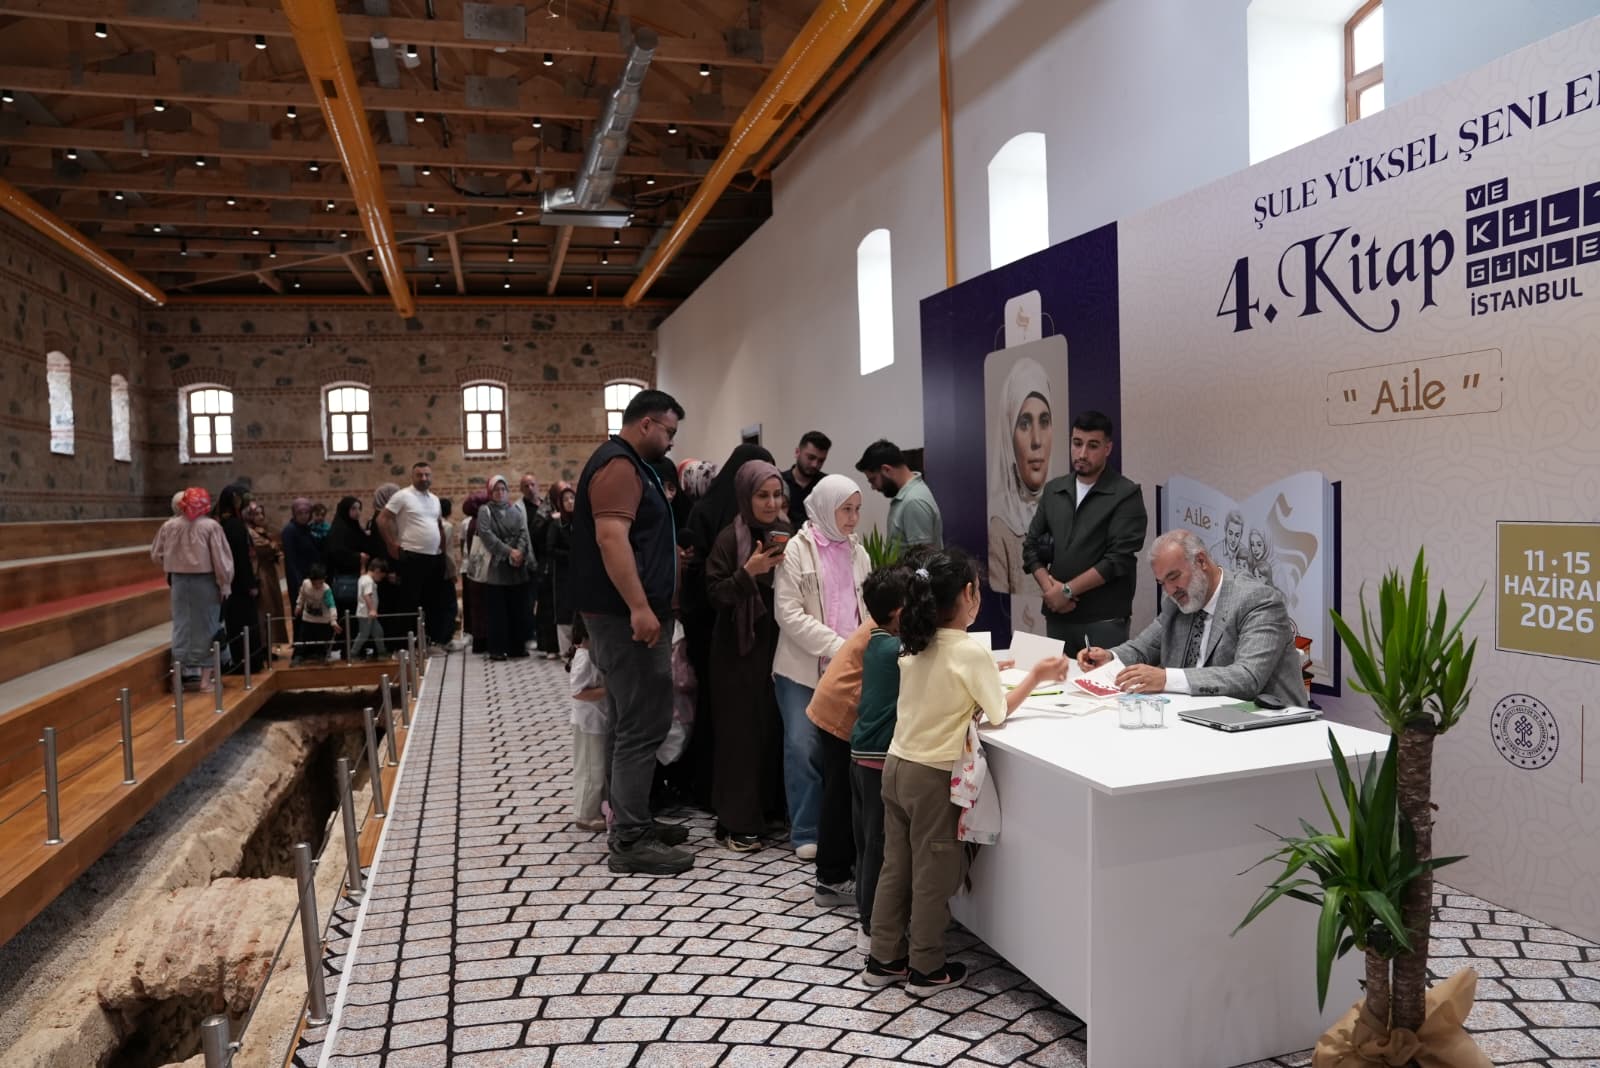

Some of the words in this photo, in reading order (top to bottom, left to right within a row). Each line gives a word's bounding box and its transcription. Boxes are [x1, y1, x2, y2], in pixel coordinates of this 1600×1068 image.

[1254, 178, 1318, 230] ŞULE
[1324, 132, 1449, 199] YÜKSEL
[1458, 70, 1600, 162] ŞENLE
[1468, 181, 1506, 208] VE
[1469, 186, 1600, 251] KÜL
[1216, 256, 1278, 333] 4.
[1278, 226, 1455, 333] Kitap
[1471, 276, 1583, 317] İSTANBUL
[1371, 367, 1446, 415] Aile
[1183, 506, 1212, 530] Aile
[1504, 572, 1600, 602] HAZİRA
[1520, 602, 1595, 633] 2026
